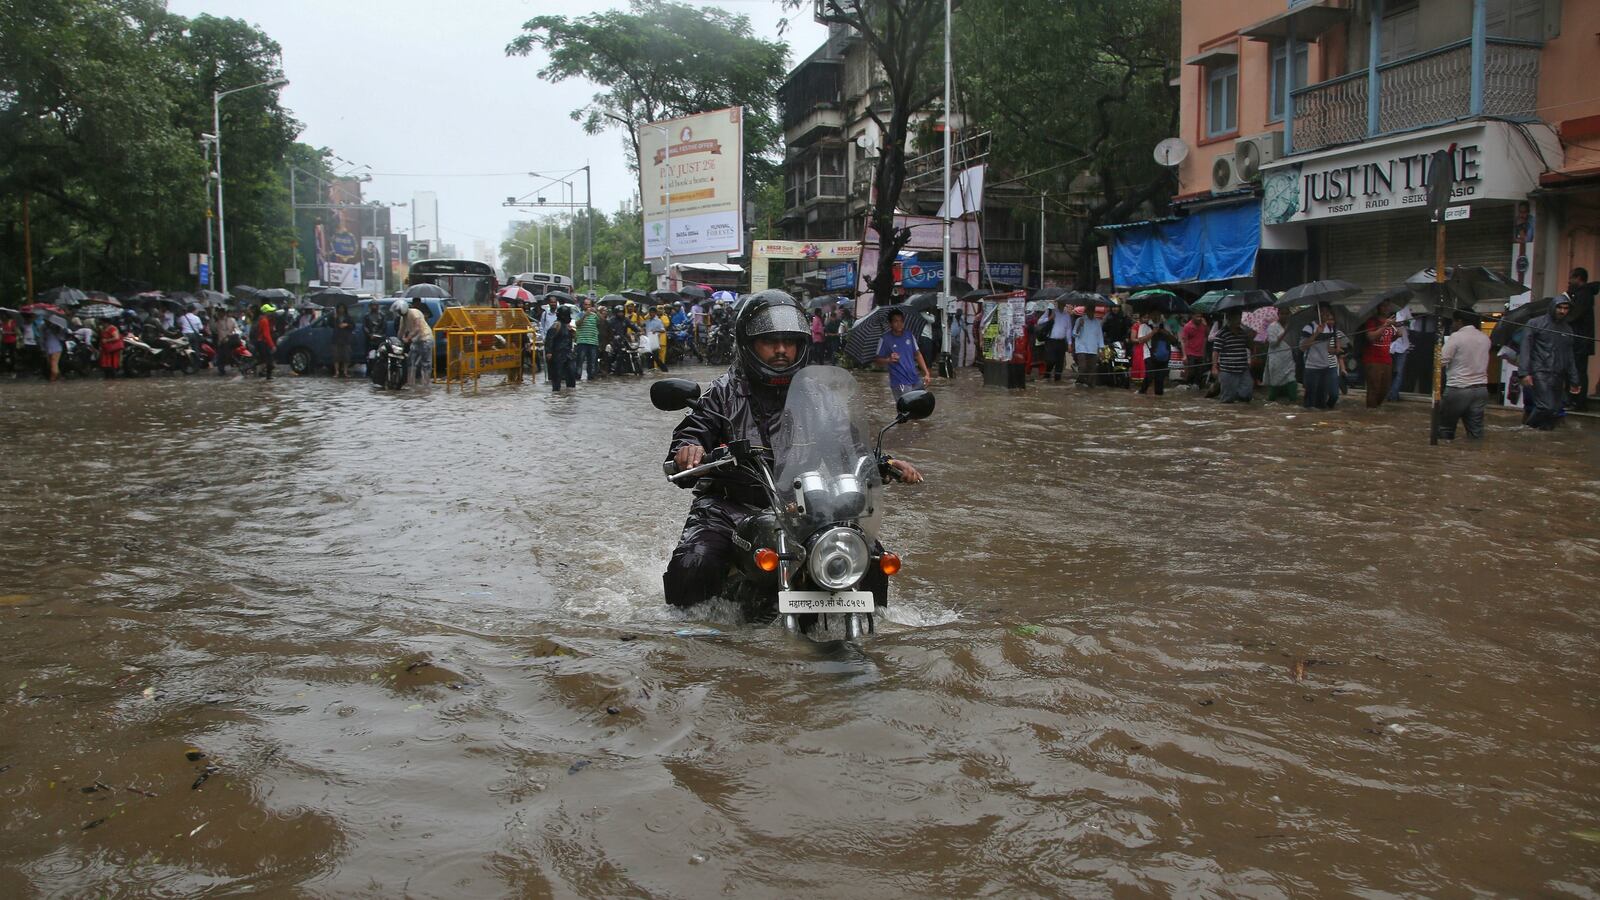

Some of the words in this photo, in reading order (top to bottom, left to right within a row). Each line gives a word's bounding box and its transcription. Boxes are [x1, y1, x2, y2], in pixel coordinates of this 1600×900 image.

[676, 161, 701, 178] JUST
[1301, 165, 1360, 213] JUST
[1362, 159, 1396, 197] IN
[1328, 203, 1353, 214] TISSOT
[1366, 199, 1390, 209] RADO
[1450, 186, 1475, 198] ASIO
